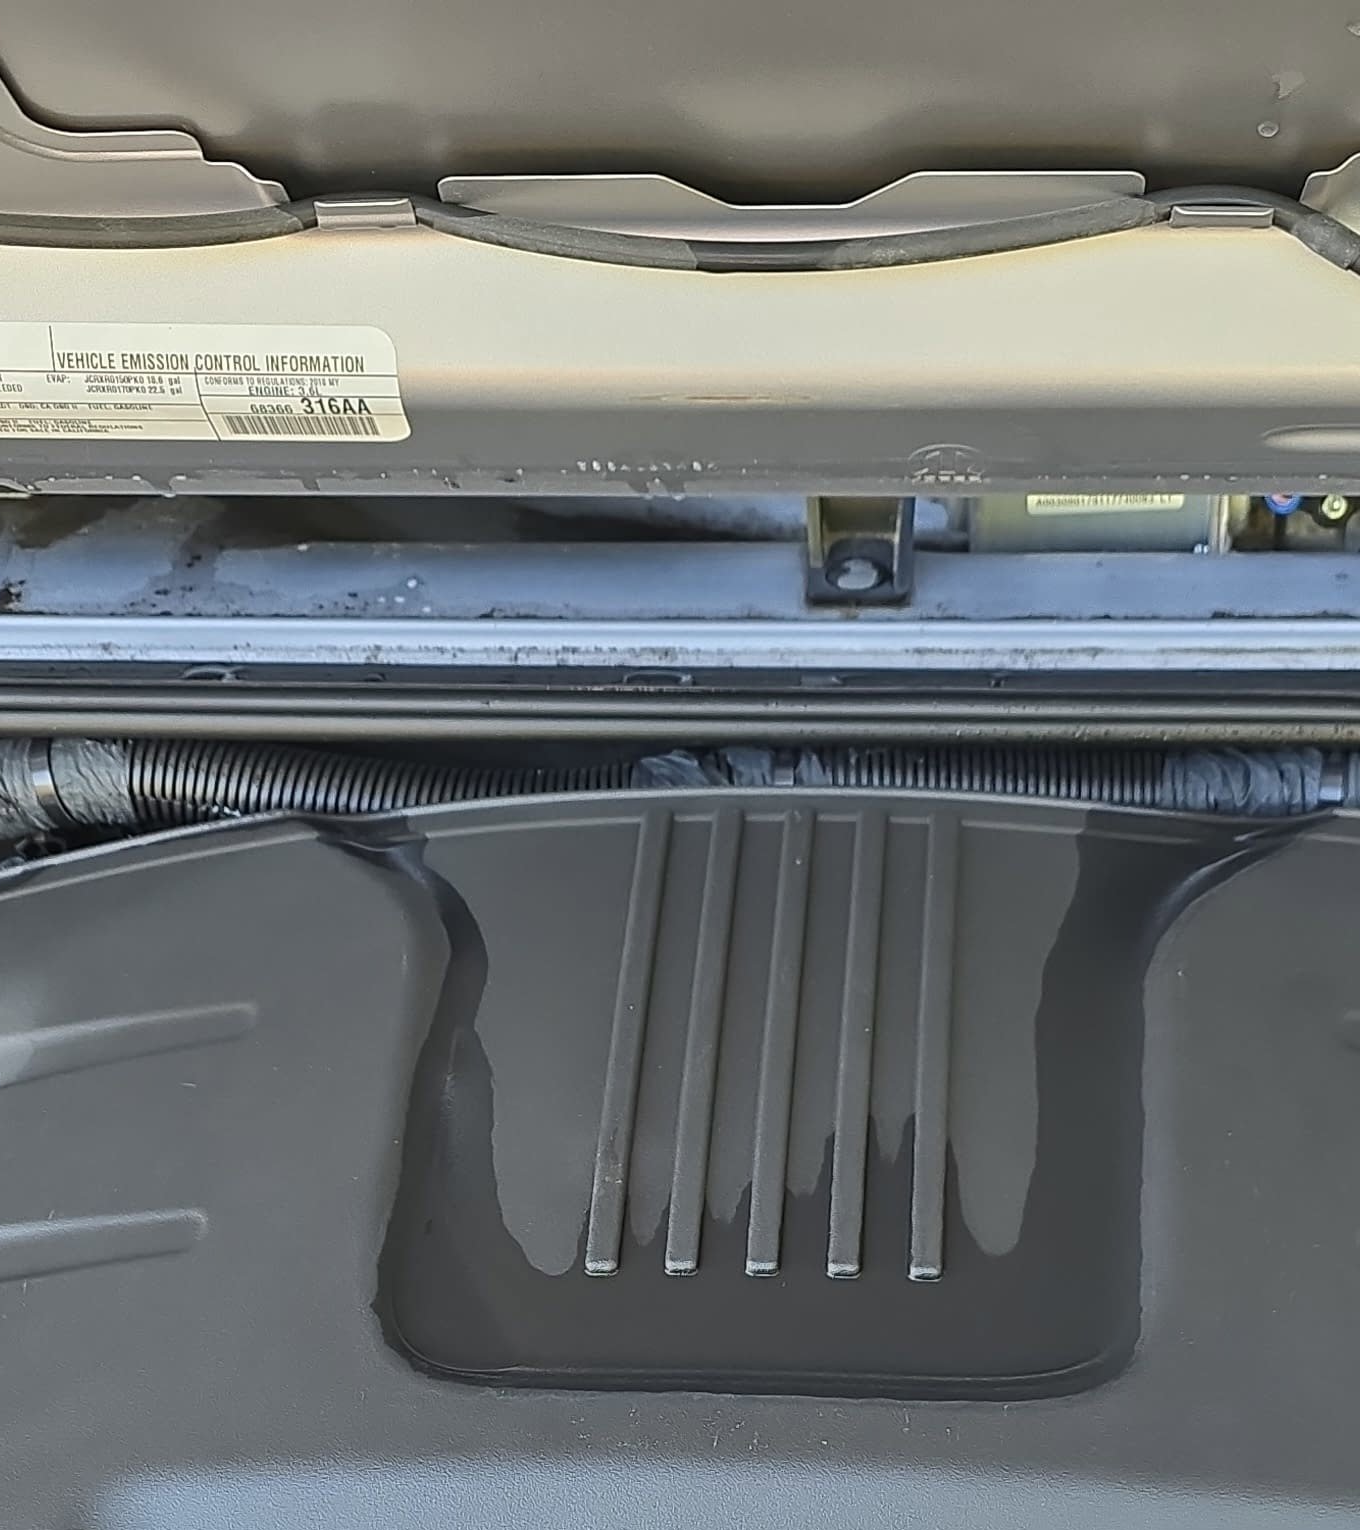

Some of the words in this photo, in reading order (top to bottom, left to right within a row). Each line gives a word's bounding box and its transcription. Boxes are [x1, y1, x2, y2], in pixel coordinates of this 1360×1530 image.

[57, 352, 116, 369] VEHICLE
[121, 353, 189, 370] EMISSION
[195, 354, 260, 371] CONTROL
[266, 355, 365, 373] INFORMATION
[300, 398, 372, 414] 316AA
